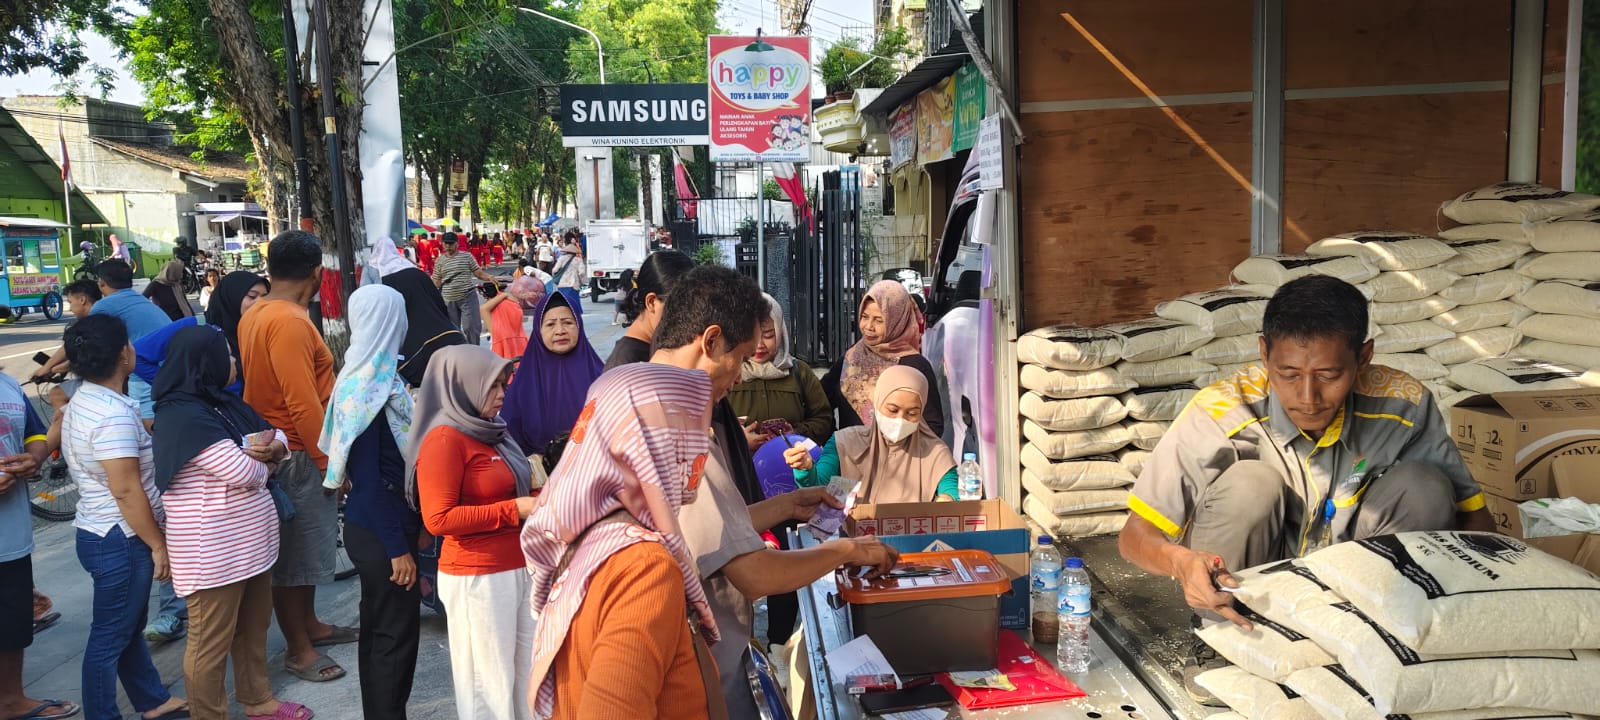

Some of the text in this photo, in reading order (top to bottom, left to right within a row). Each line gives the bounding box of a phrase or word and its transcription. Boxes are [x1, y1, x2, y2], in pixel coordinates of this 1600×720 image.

[719, 62, 799, 88] happy
[730, 92, 746, 100] TOYS
[753, 92, 772, 100] BABY
[773, 92, 789, 100] SHOP
[571, 99, 706, 122] SAMSUNG
[1442, 544, 1500, 581] MEDIUM
